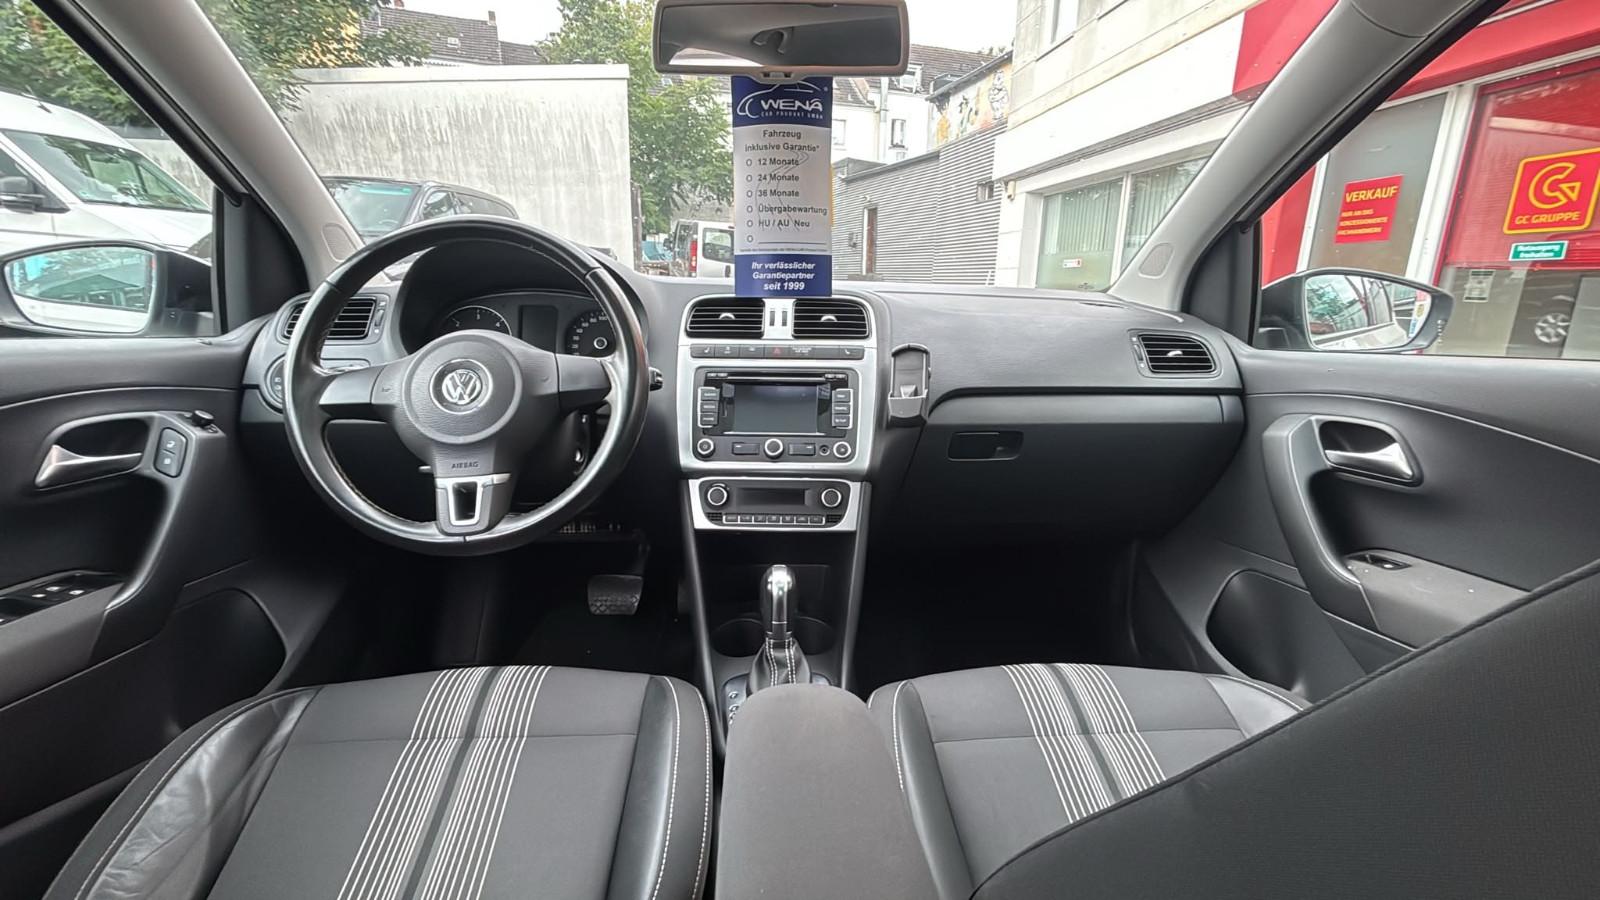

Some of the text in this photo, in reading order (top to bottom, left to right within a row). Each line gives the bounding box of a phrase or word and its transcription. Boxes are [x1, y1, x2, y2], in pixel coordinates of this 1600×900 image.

[763, 130, 802, 139] Fahrzeug
[1345, 185, 1399, 203] VERKAUF
[758, 204, 828, 216] Übergabewartung
[1515, 211, 1582, 225] GC GRUPPE
[765, 261, 816, 269] verlässlicher
[752, 271, 816, 281] Garantiepartner
[763, 282, 805, 290] seit 1999
[451, 461, 479, 469] AIRBAG
